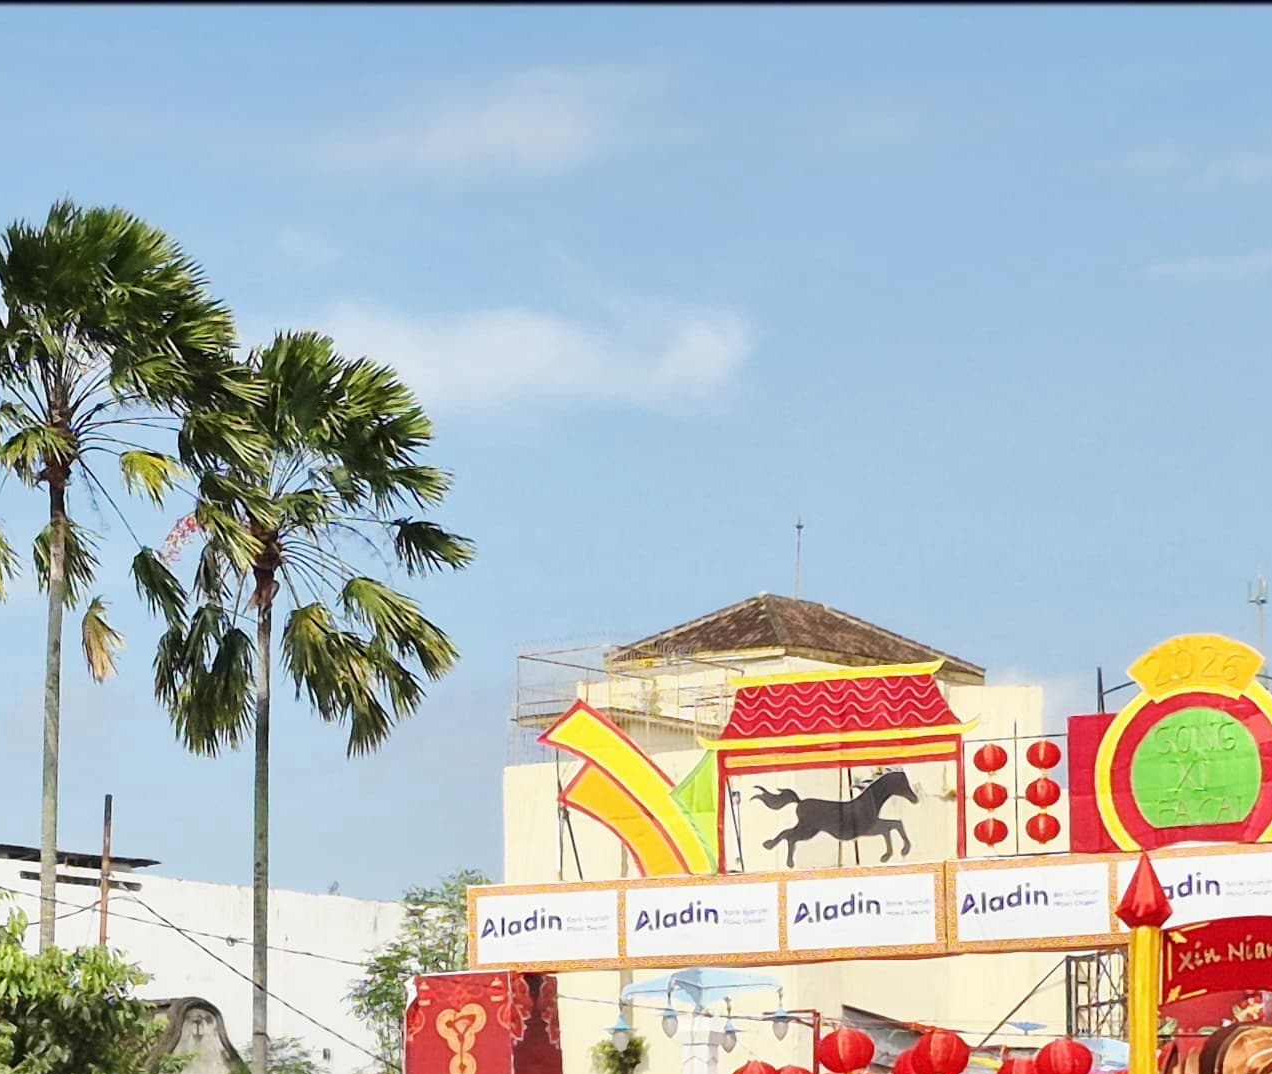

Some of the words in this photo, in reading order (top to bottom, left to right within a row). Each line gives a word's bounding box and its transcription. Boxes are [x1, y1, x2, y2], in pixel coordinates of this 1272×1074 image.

[1143, 645, 1247, 687] 2026
[1154, 722, 1238, 755] GONG
[1157, 798, 1192, 823] FA
[1198, 795, 1243, 823] CAI
[793, 891, 881, 924] Aladin
[960, 882, 1049, 915] Aladin
[481, 907, 563, 939] Aladin
[634, 900, 719, 932] Aladin
[1178, 940, 1222, 973] Xin
